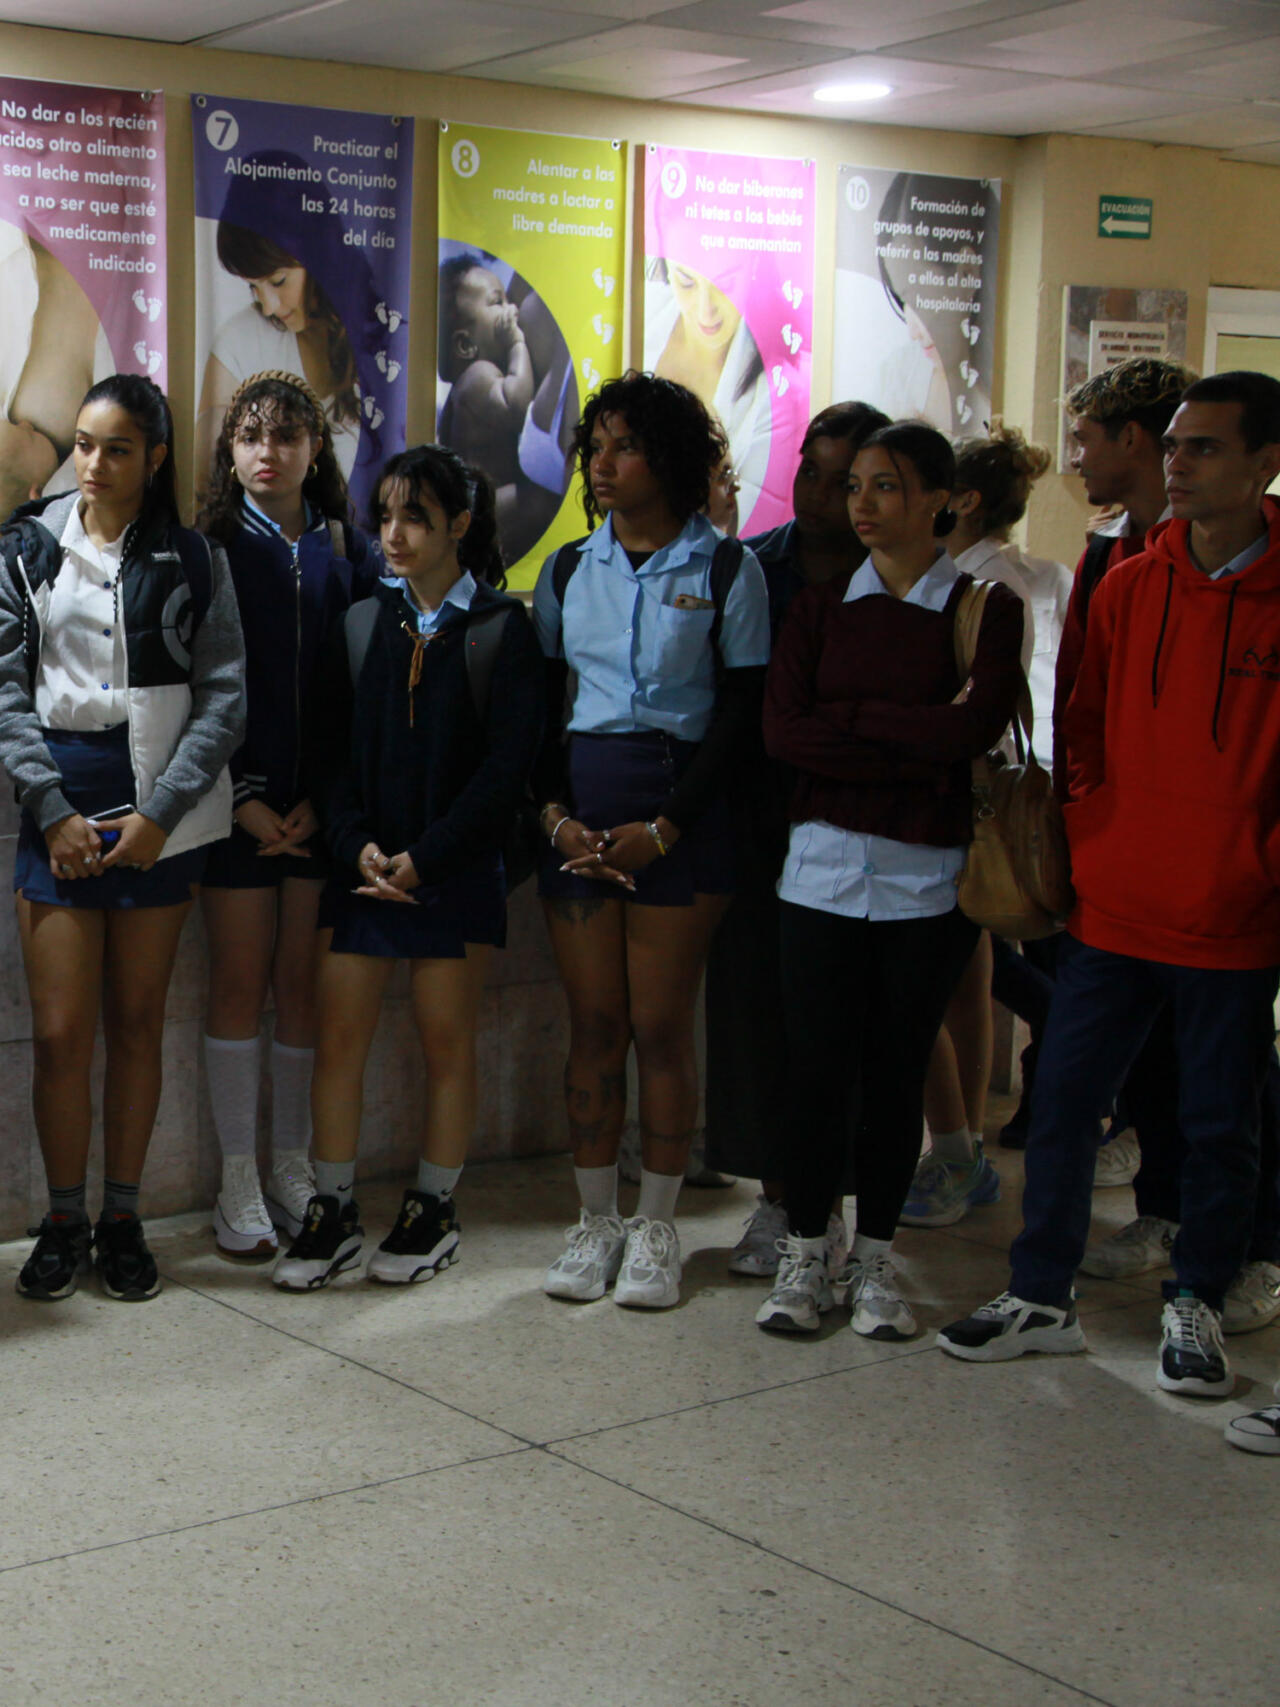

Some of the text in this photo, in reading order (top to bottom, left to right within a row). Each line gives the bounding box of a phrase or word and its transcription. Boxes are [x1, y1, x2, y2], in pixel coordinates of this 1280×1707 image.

[2, 100, 157, 131] No dar a los recién
[214, 117, 232, 145] 7
[49, 136, 81, 154] otro
[88, 138, 157, 160] alimento
[314, 135, 398, 159] Practicar el
[458, 146, 473, 171] 8
[4, 164, 32, 178] sea
[37, 162, 80, 182] leche
[85, 170, 157, 190] materna,
[224, 156, 397, 190] Alojamiento Conjunto
[527, 158, 615, 181] Alentar a las
[668, 168, 680, 192] 9
[493, 186, 613, 209] madres a lactar a
[696, 176, 803, 199] No dar biberones
[850, 183, 865, 204] 10
[19, 194, 156, 217] a no ser que esté
[302, 194, 396, 220] las 24 horas
[686, 202, 697, 218] ni
[734, 211, 742, 222] a
[747, 206, 763, 224] los
[768, 208, 802, 226] bebés
[911, 196, 985, 217] Formación de
[50, 224, 156, 245] medicamente
[512, 214, 613, 238] libre demanda
[873, 220, 984, 243] grupos de apoyos, y
[343, 229, 395, 248] del día
[701, 235, 802, 253] que amamantan
[89, 254, 156, 274] indicado
[876, 242, 982, 264] referir a las madres
[909, 275, 916, 284] a
[948, 272, 959, 287] al
[962, 274, 981, 289] alta
[916, 296, 980, 313] hospitalaria
